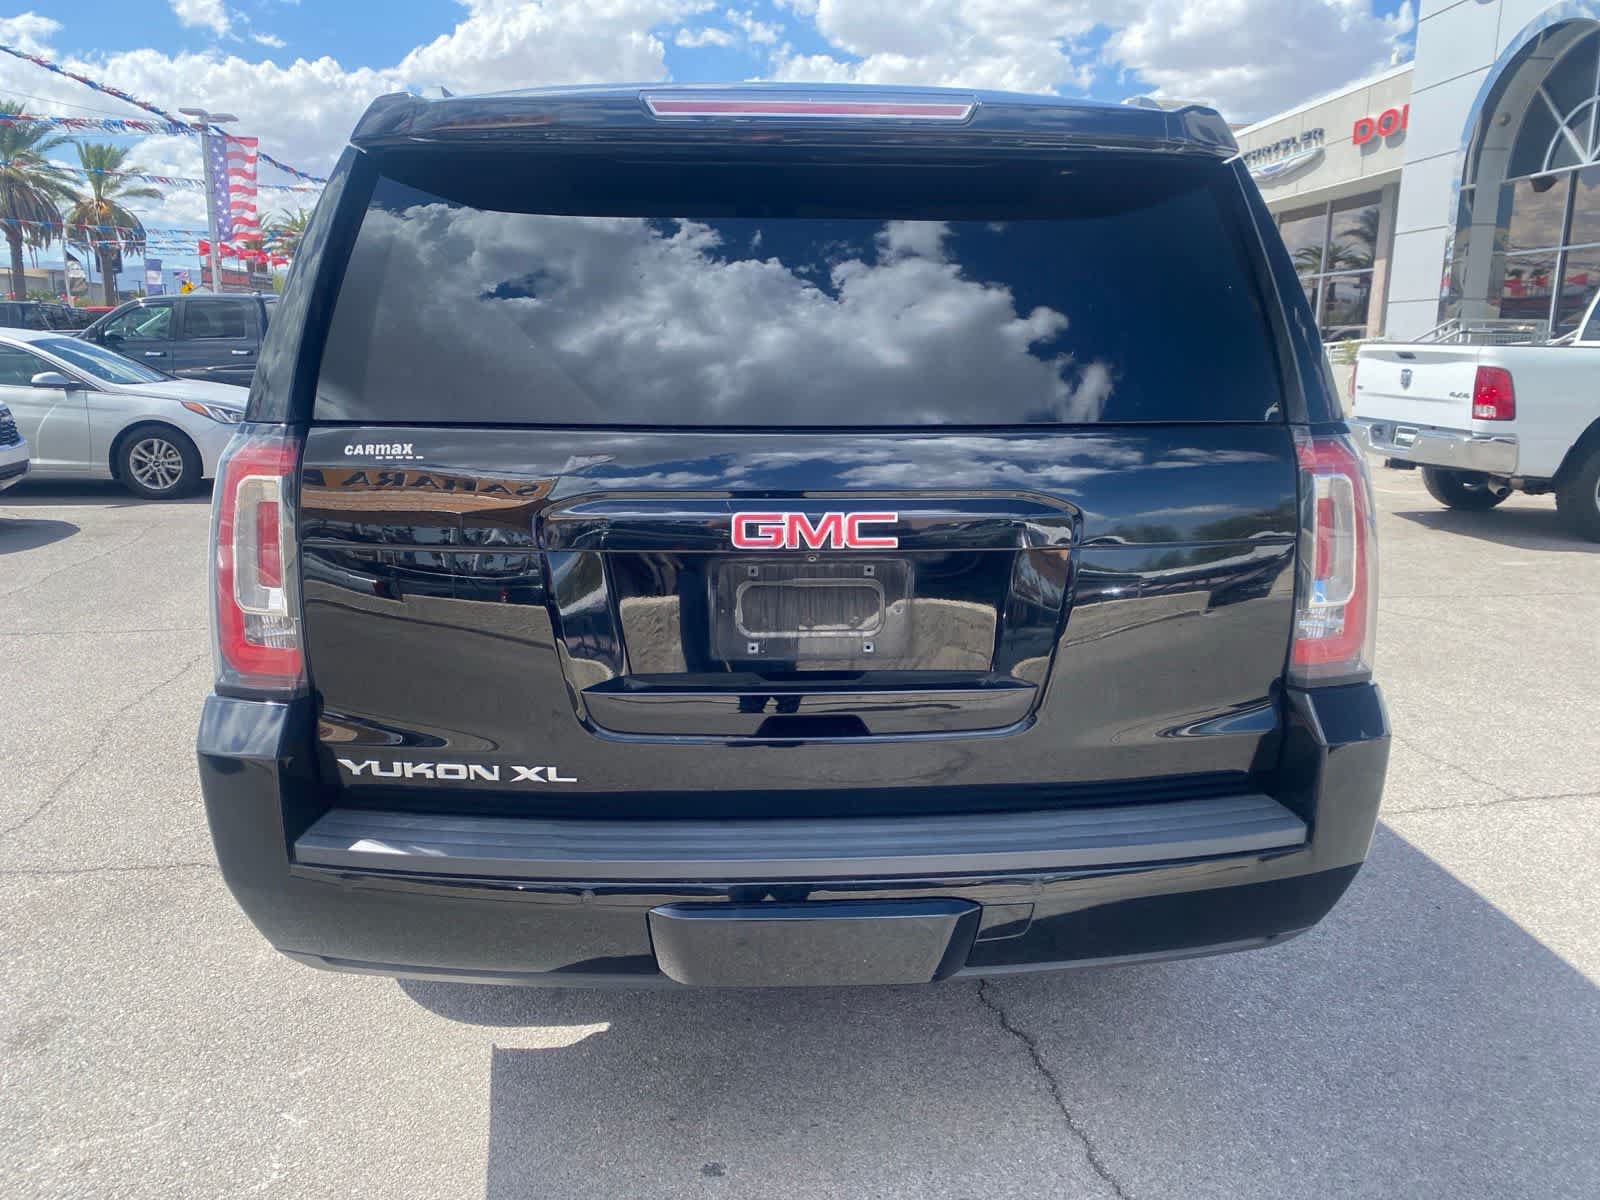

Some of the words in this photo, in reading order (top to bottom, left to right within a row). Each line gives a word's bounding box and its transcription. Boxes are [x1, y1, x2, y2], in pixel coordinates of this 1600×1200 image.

[731, 511, 899, 549] GMC
[336, 758, 501, 781] YUKON
[510, 766, 578, 783] XL
